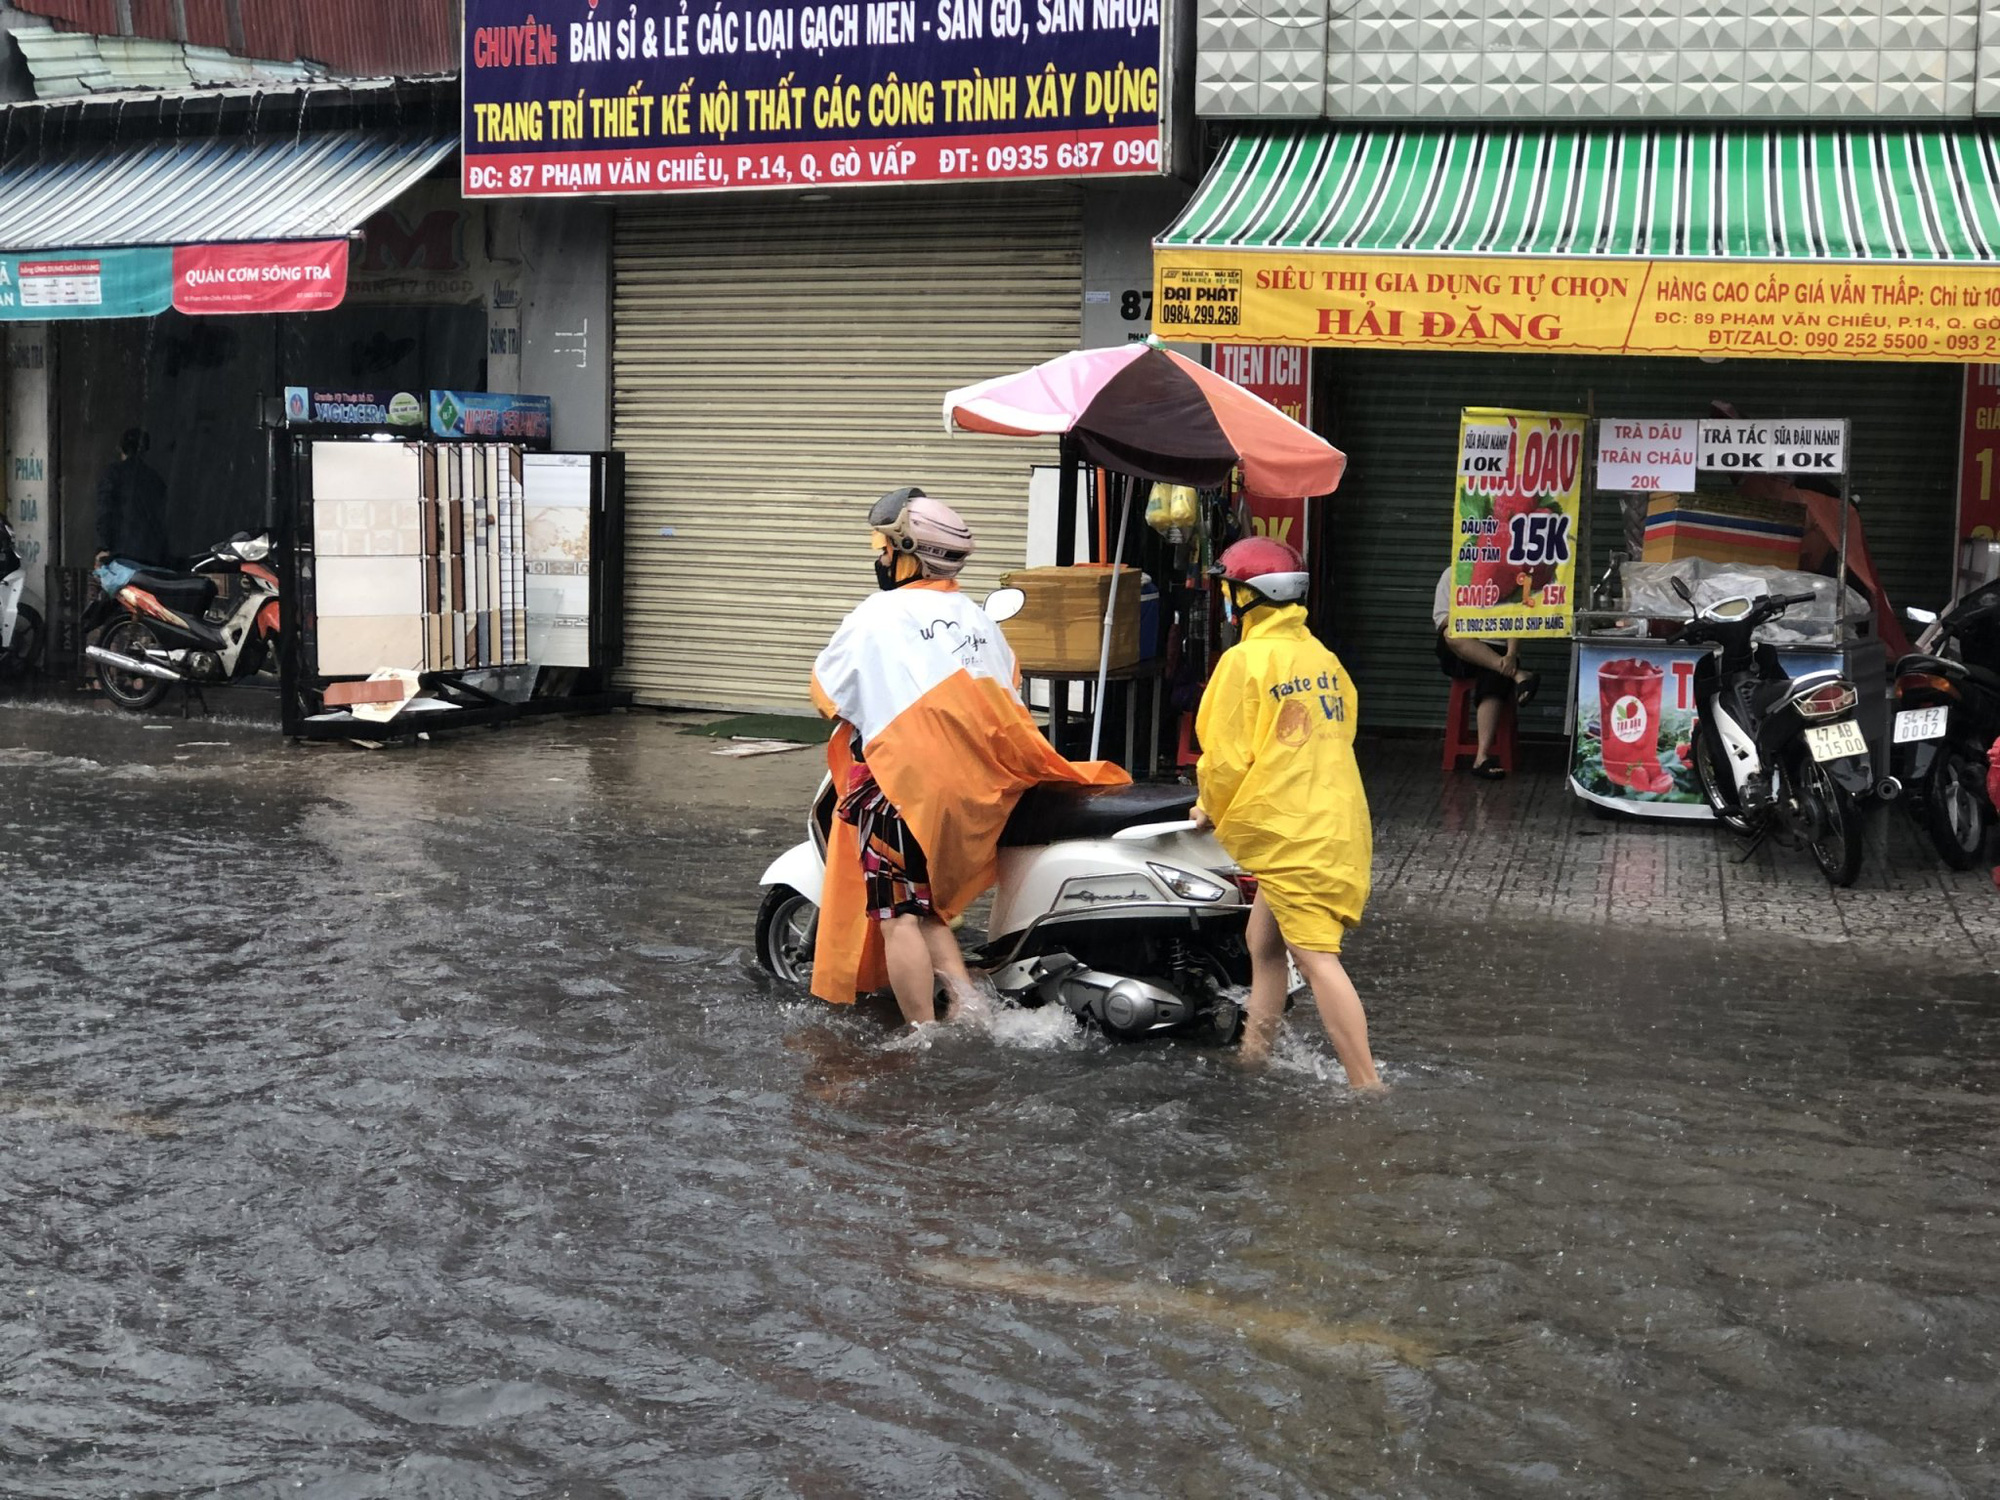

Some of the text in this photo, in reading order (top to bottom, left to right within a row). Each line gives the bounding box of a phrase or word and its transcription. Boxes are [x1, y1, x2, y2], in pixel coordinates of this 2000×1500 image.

[474, 14, 558, 68] CHUYÊN:
[569, 11, 611, 62] BÁN
[616, 3, 637, 60] SỈ
[641, 17, 658, 58] &
[664, 0, 689, 57] LẺ
[697, 2, 739, 55] CÁC
[745, 8, 793, 59] LOẠI
[801, 3, 857, 56] GẠCH
[866, 1, 916, 46] MEN
[474, 61, 1158, 142] TRANG TRÍ THIẾT KẾ NỘI THẤT CÁC CÔNG TRÌNH XÂY DỰNG
[469, 139, 1160, 190] ĐC: 87 PHẠM VĂN CHIÊU, P.14, Q. GÒ VẤP ĐT: 0935 687 090
[185, 266, 225, 287] QUÁN
[226, 266, 258, 282] CƠM
[261, 264, 301, 282] SÔNG
[1256, 265, 1630, 304] SIÊU THỊ GIA DỤNG TỰ CHỌN
[1164, 284, 1238, 304] ĐẠI PHÁT
[1657, 275, 1706, 302] HÀNG
[1712, 282, 1749, 303] CAO
[1755, 273, 1789, 303] CẤP
[1795, 278, 1825, 304] GIÁ
[1830, 274, 1866, 304] VẪN
[1872, 275, 1924, 306] THẤP:
[1930, 285, 1957, 307] Chỉ
[1963, 286, 1981, 307] từ
[1120, 290, 1154, 321] 87
[1163, 304, 1238, 325] 0984.299.258
[1315, 300, 1563, 341] HẢI ĐĂNG
[1655, 312, 2000, 330] ĐC: 89 PHẠM VĂN CHIÊU, P.14, Q. GÒ
[1708, 329, 1798, 347] ĐT/ZALO:
[1805, 332, 1838, 347] 090
[1844, 333, 1877, 348] 252
[1883, 333, 1928, 349] 5500
[1946, 335, 1979, 350] 093
[1986, 336, 2000, 350] 2
[315, 403, 388, 424] VIGLACERA
[1614, 423, 1682, 440] TRÀ DÂU
[1703, 422, 1767, 445] TRÀ TẮC
[1794, 425, 1812, 449] ĐẬU
[1601, 447, 1693, 465] TRÂN CHÂU
[1706, 453, 1763, 468] 10K
[1777, 453, 1836, 468] 10K
[1630, 475, 1660, 489] 20K
[1461, 515, 1499, 535] DÂU TÂY
[1509, 516, 1570, 562] 15K
[1459, 544, 1479, 561] DÂU
[1456, 578, 1500, 607] CAM ÉP
[1543, 585, 1566, 605] 15K
[1902, 723, 1938, 738] 0002
